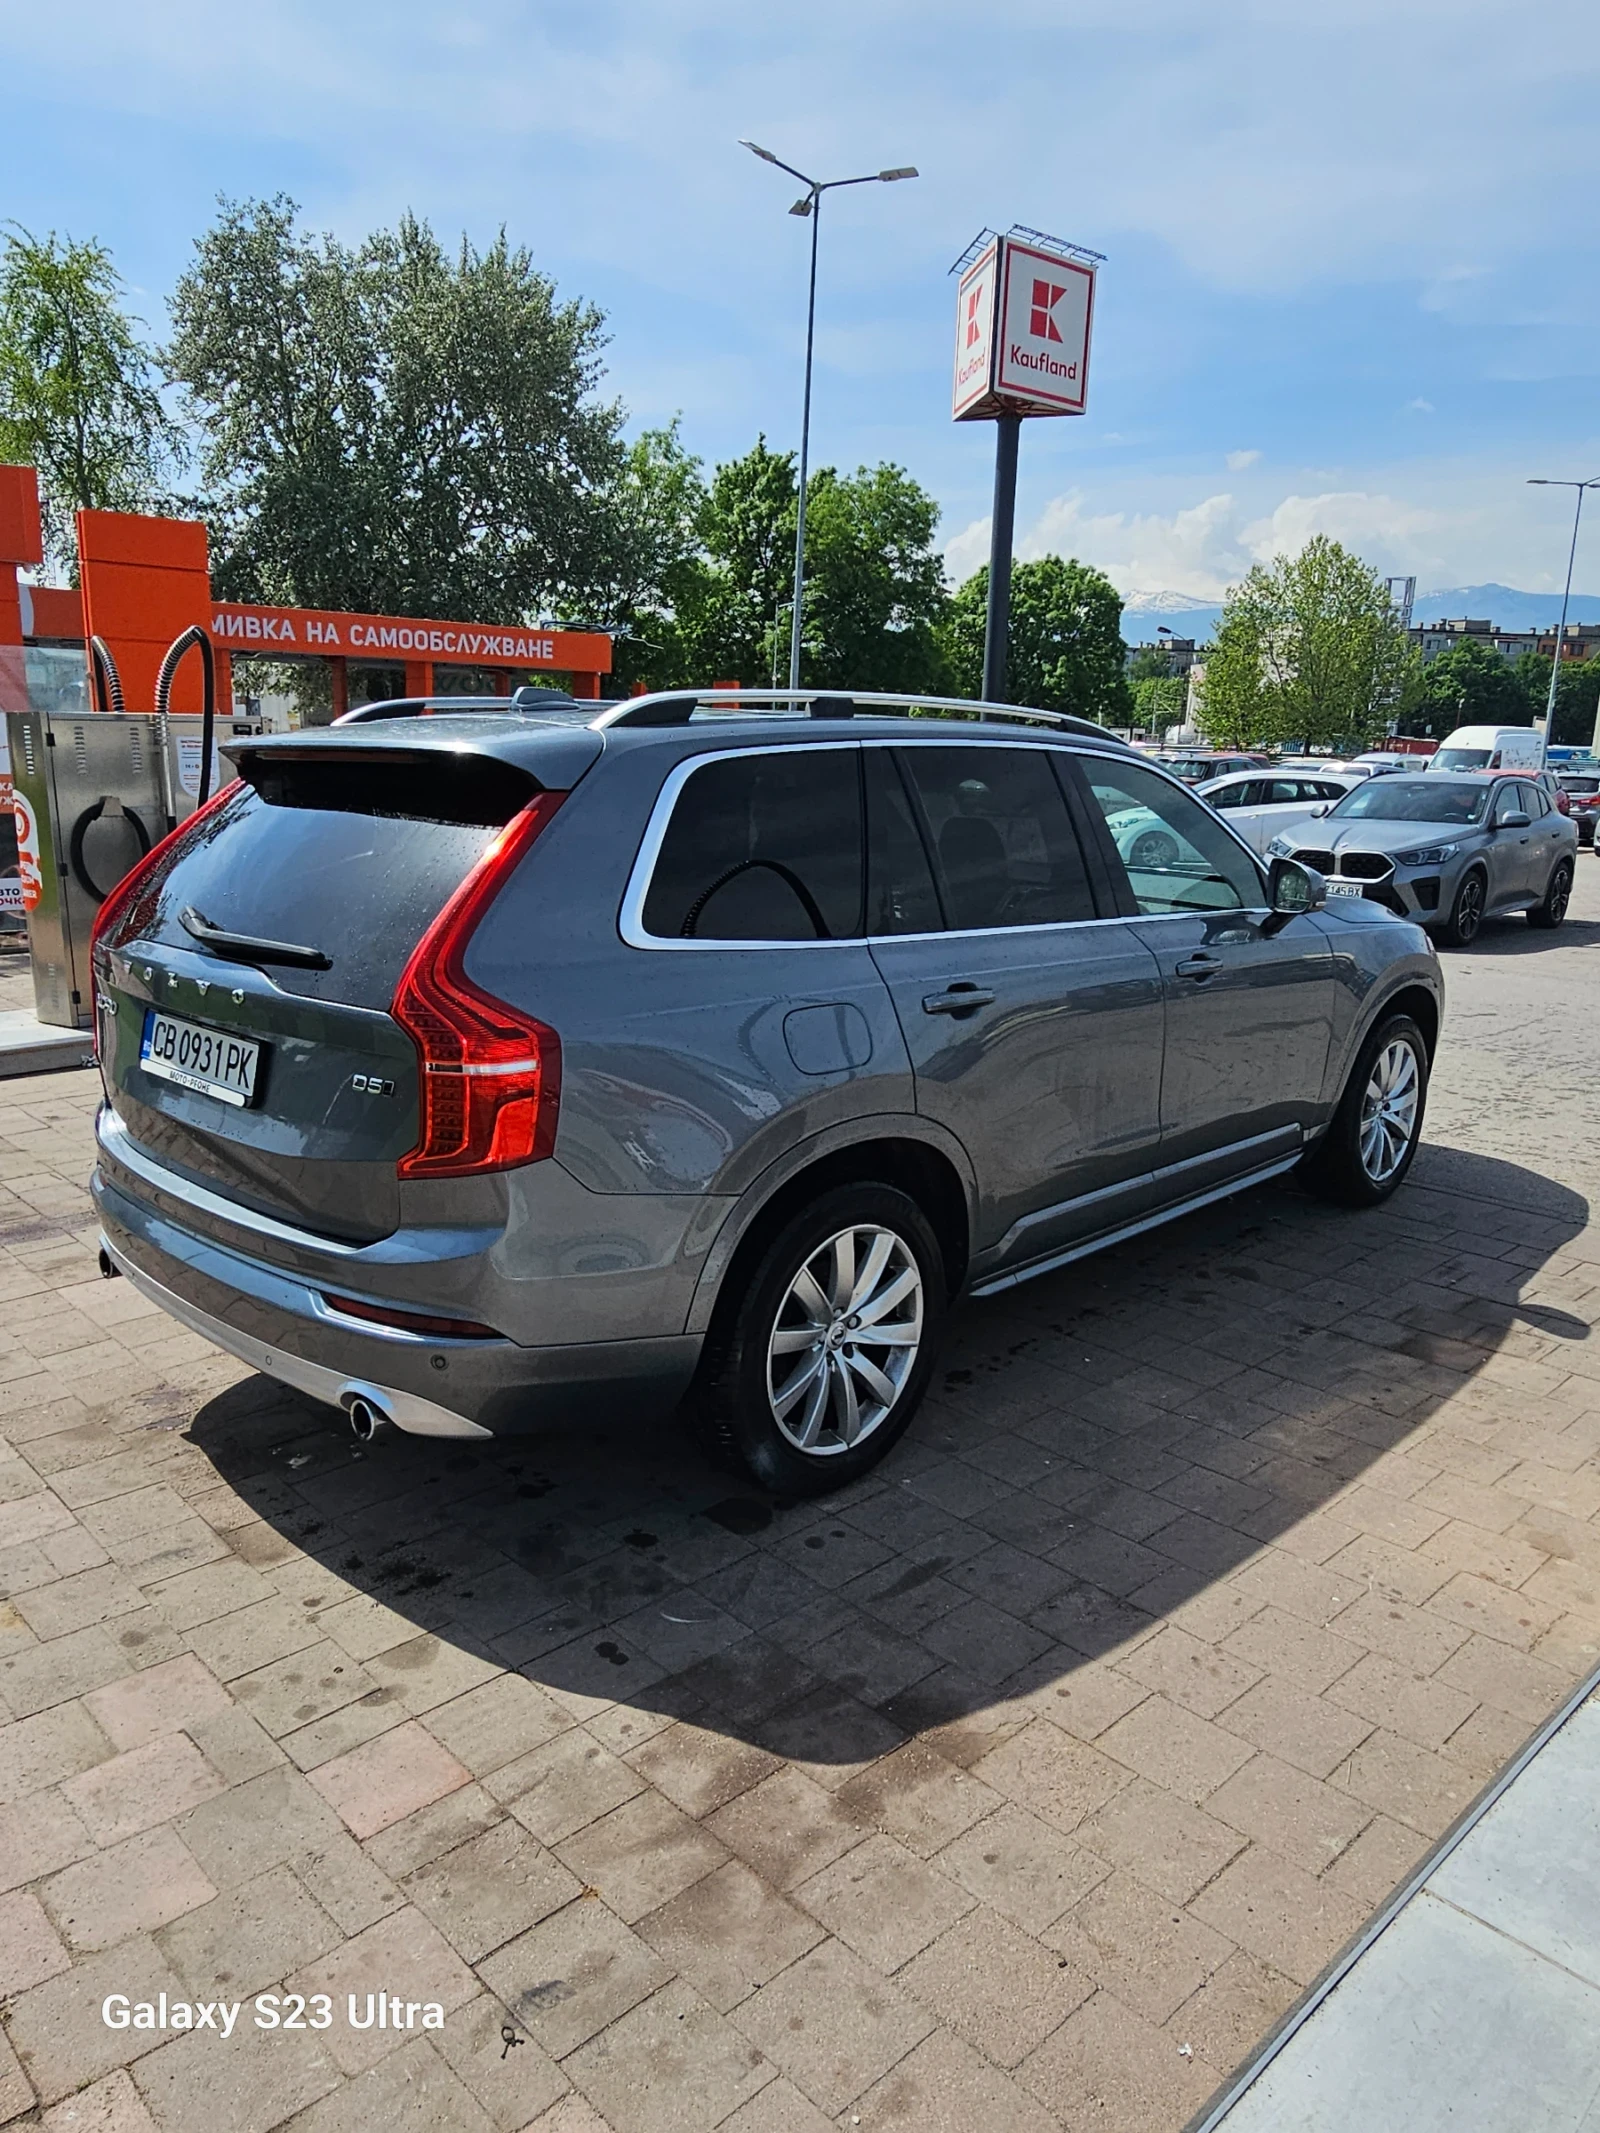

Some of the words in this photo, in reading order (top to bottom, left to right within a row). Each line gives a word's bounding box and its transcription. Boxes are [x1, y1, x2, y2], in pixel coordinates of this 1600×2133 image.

[959, 346, 986, 386] Kaufland
[1010, 344, 1077, 380] Kaufland
[306, 621, 340, 645] НА
[350, 624, 554, 659] САМООБСЛУЖВАНЕ
